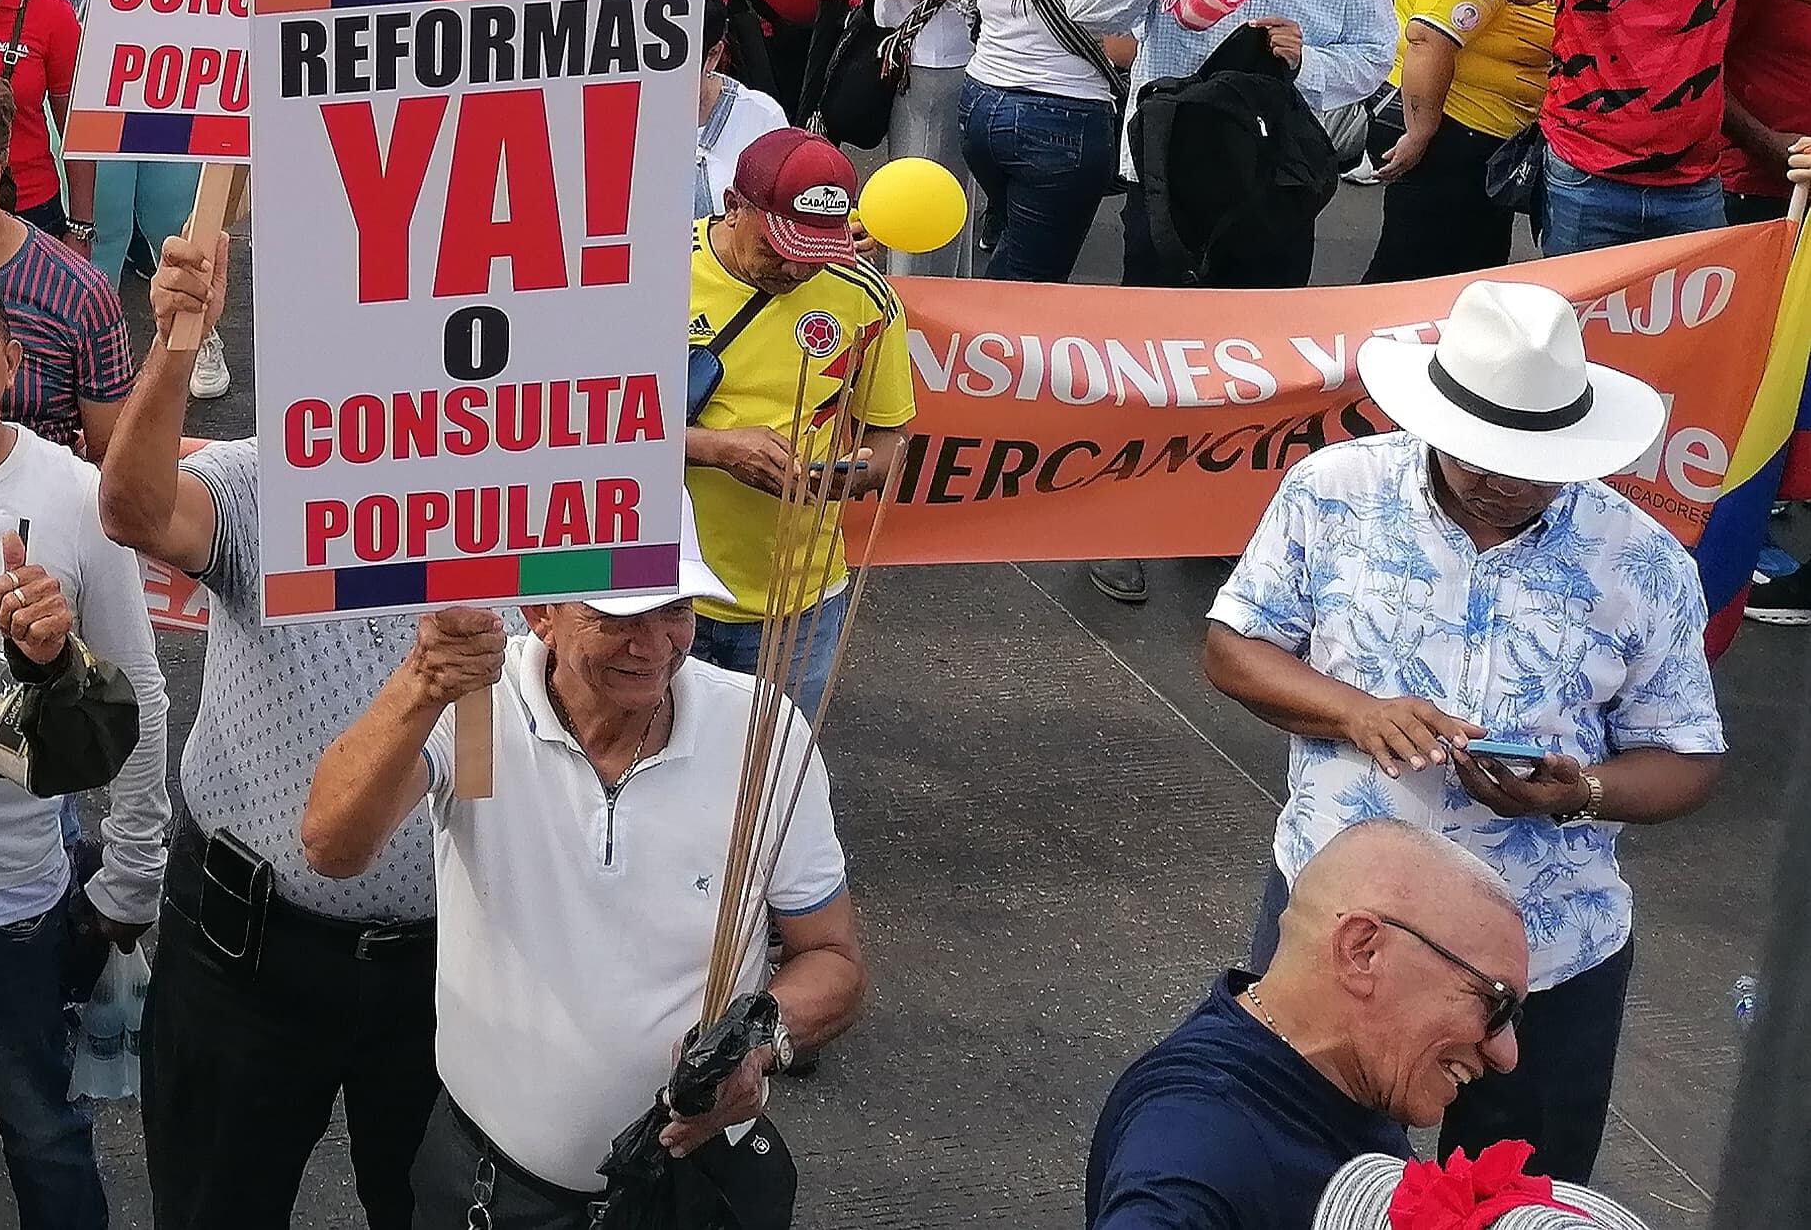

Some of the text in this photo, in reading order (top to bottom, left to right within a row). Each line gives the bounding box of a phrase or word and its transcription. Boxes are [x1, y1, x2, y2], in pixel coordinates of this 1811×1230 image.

[105, 43, 251, 113] POPU
[318, 80, 643, 305] YA!
[443, 304, 511, 382] O
[907, 328, 1345, 410] NSIONES Y
[284, 373, 666, 469] CONSULTA
[305, 476, 641, 567] POPULAR
